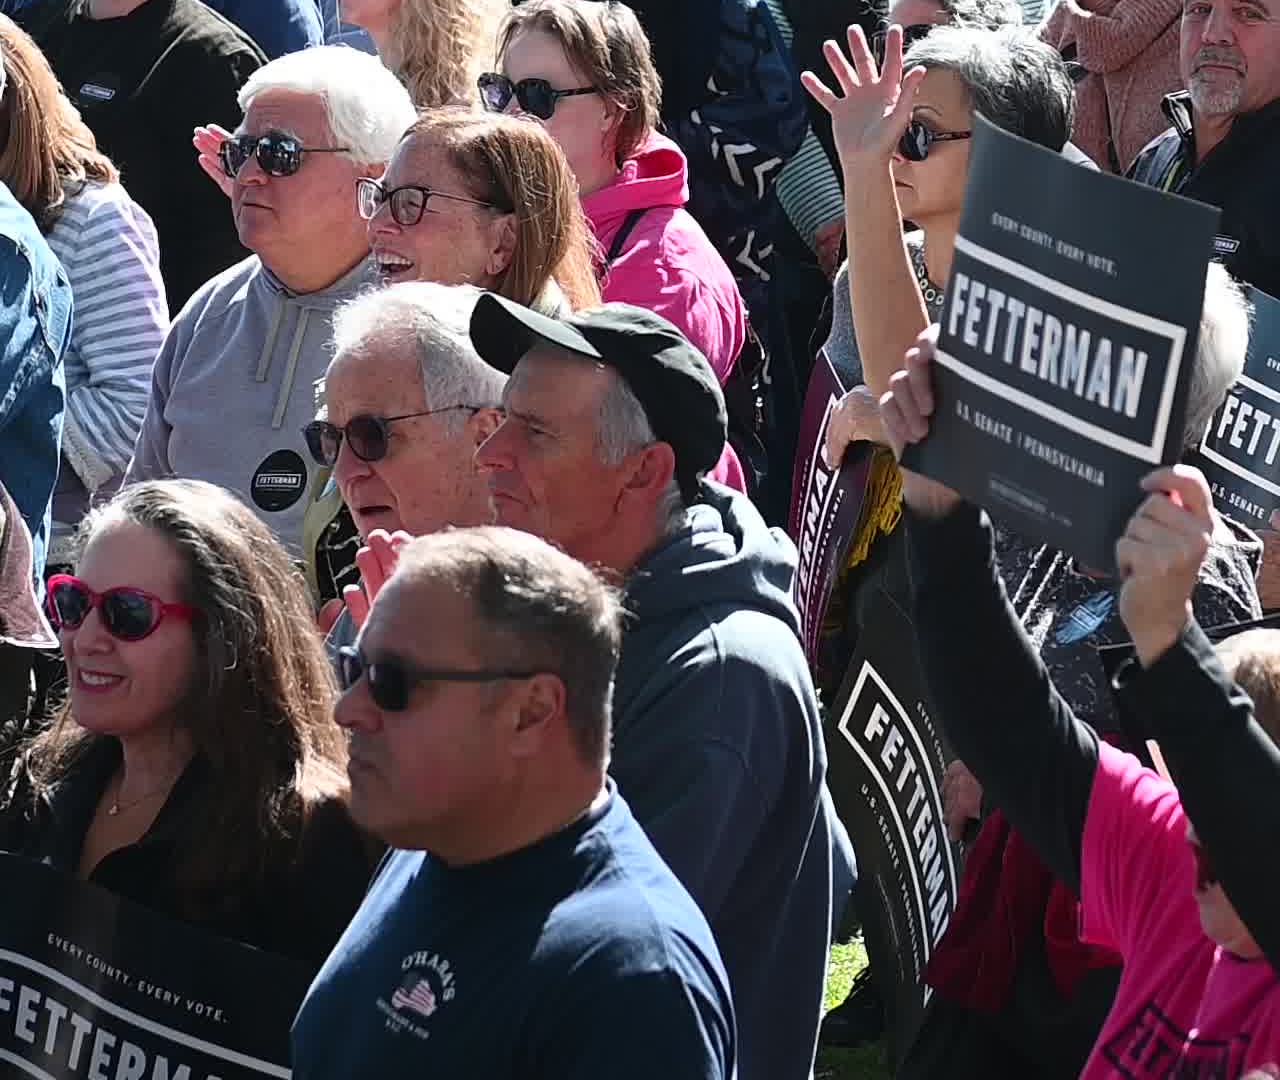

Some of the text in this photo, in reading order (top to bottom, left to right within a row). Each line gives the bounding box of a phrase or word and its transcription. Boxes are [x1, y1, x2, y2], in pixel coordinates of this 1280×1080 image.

[949, 272, 1148, 418] FETTERMAN
[1228, 492, 1265, 519] SENATE
[864, 703, 949, 950] FETTERMA
[47, 933, 229, 1023] EVERY COUNTY. EVERY VOTE.
